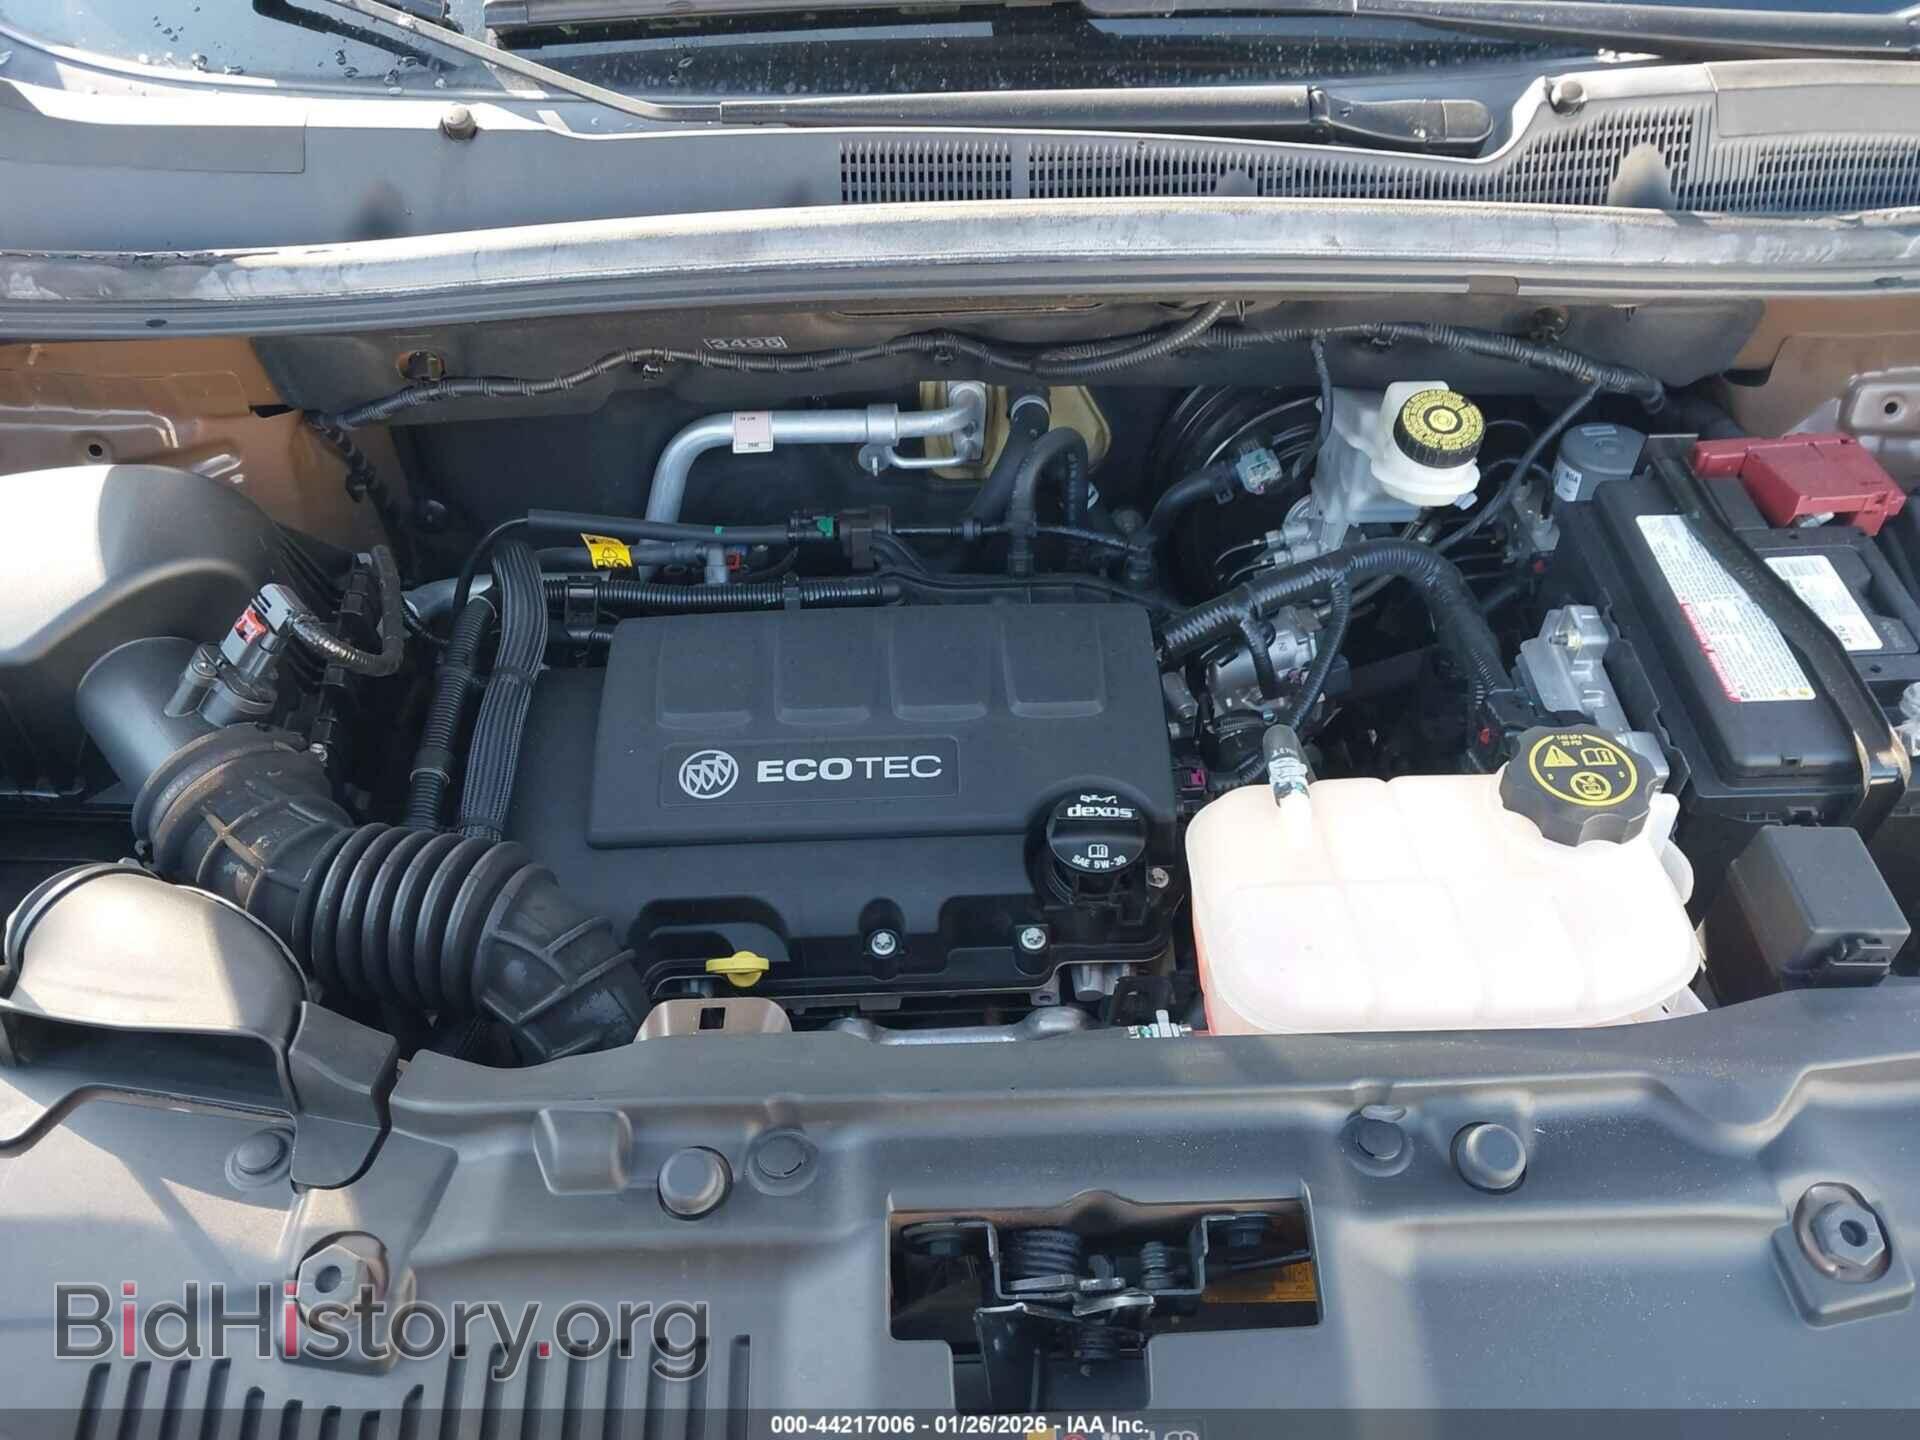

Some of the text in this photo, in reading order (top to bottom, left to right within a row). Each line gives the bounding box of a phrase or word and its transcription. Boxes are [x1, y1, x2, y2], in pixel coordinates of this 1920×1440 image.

[757, 754, 943, 783] ECOTEC
[1067, 804, 1134, 818] dexos
[1071, 854, 1126, 869] SAE 5W-30
